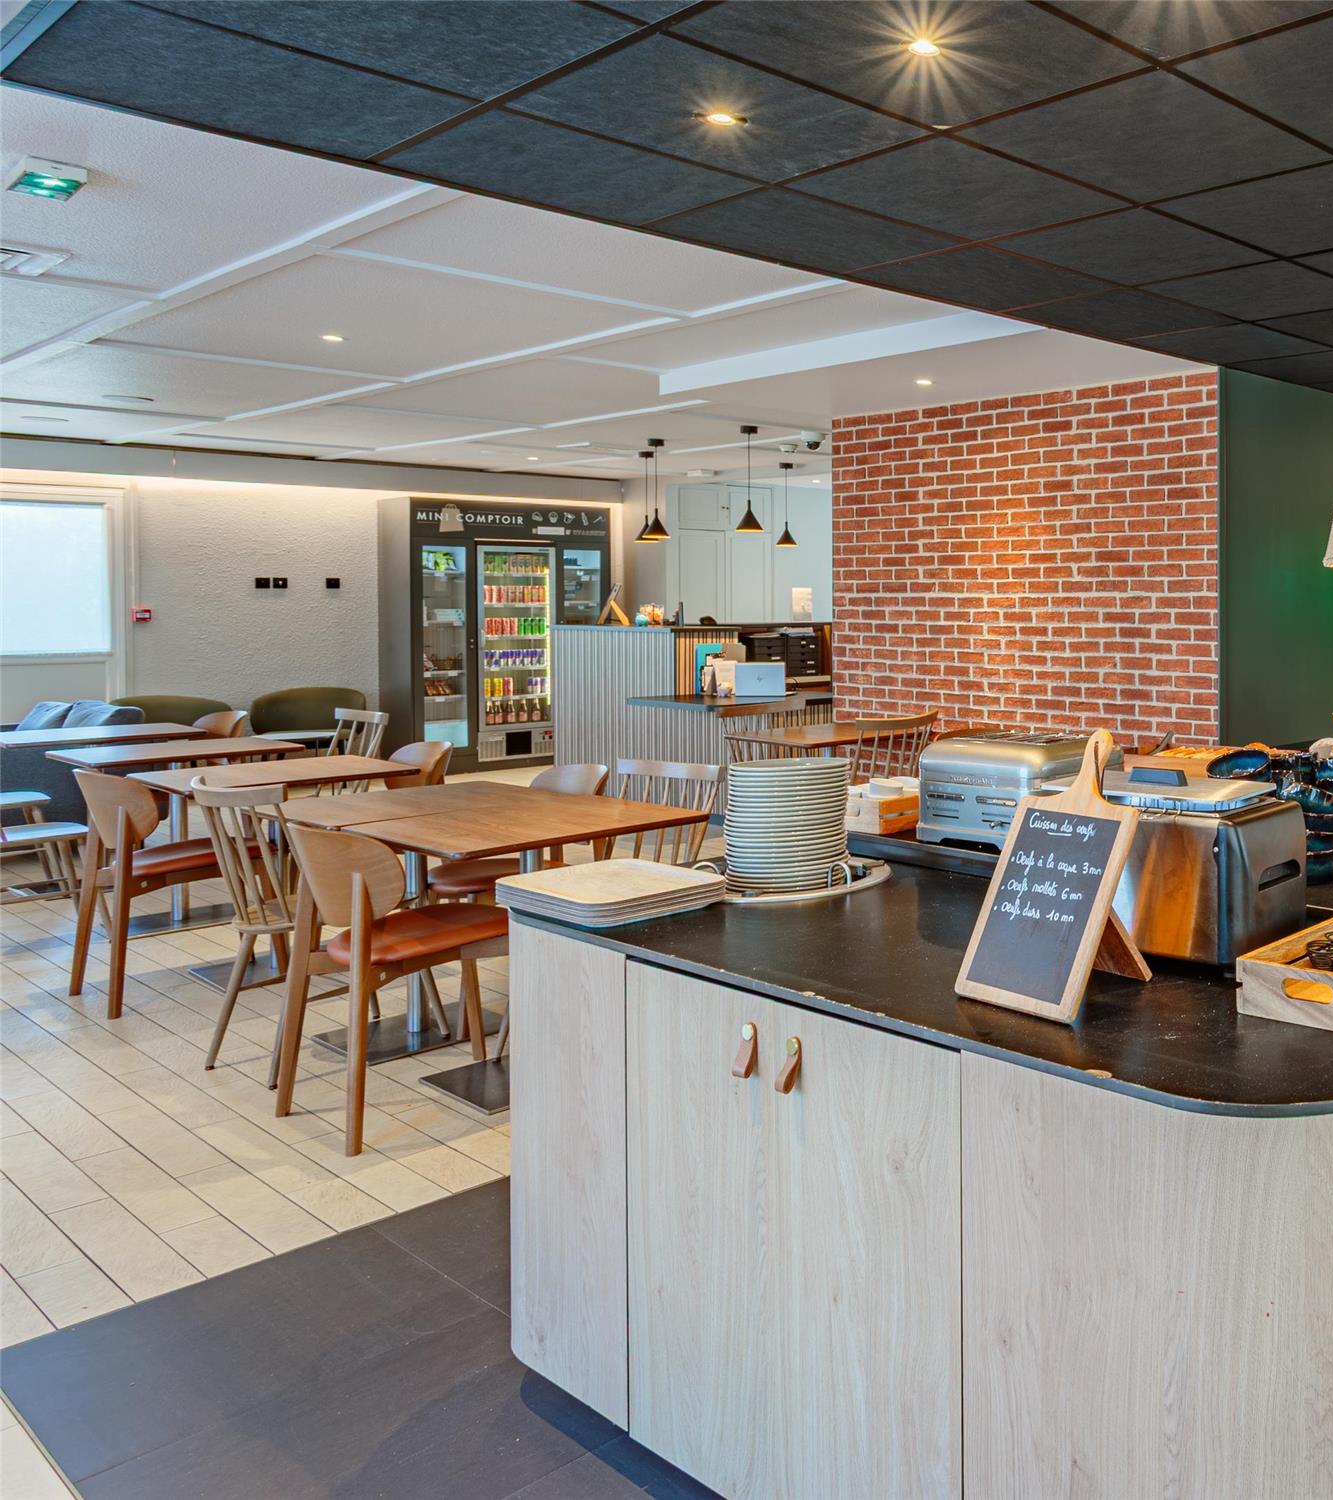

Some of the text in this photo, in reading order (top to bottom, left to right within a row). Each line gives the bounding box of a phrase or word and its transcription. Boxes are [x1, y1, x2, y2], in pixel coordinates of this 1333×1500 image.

[416, 511, 524, 525] MINI COMPTOIR
[1046, 853, 1054, 868] la
